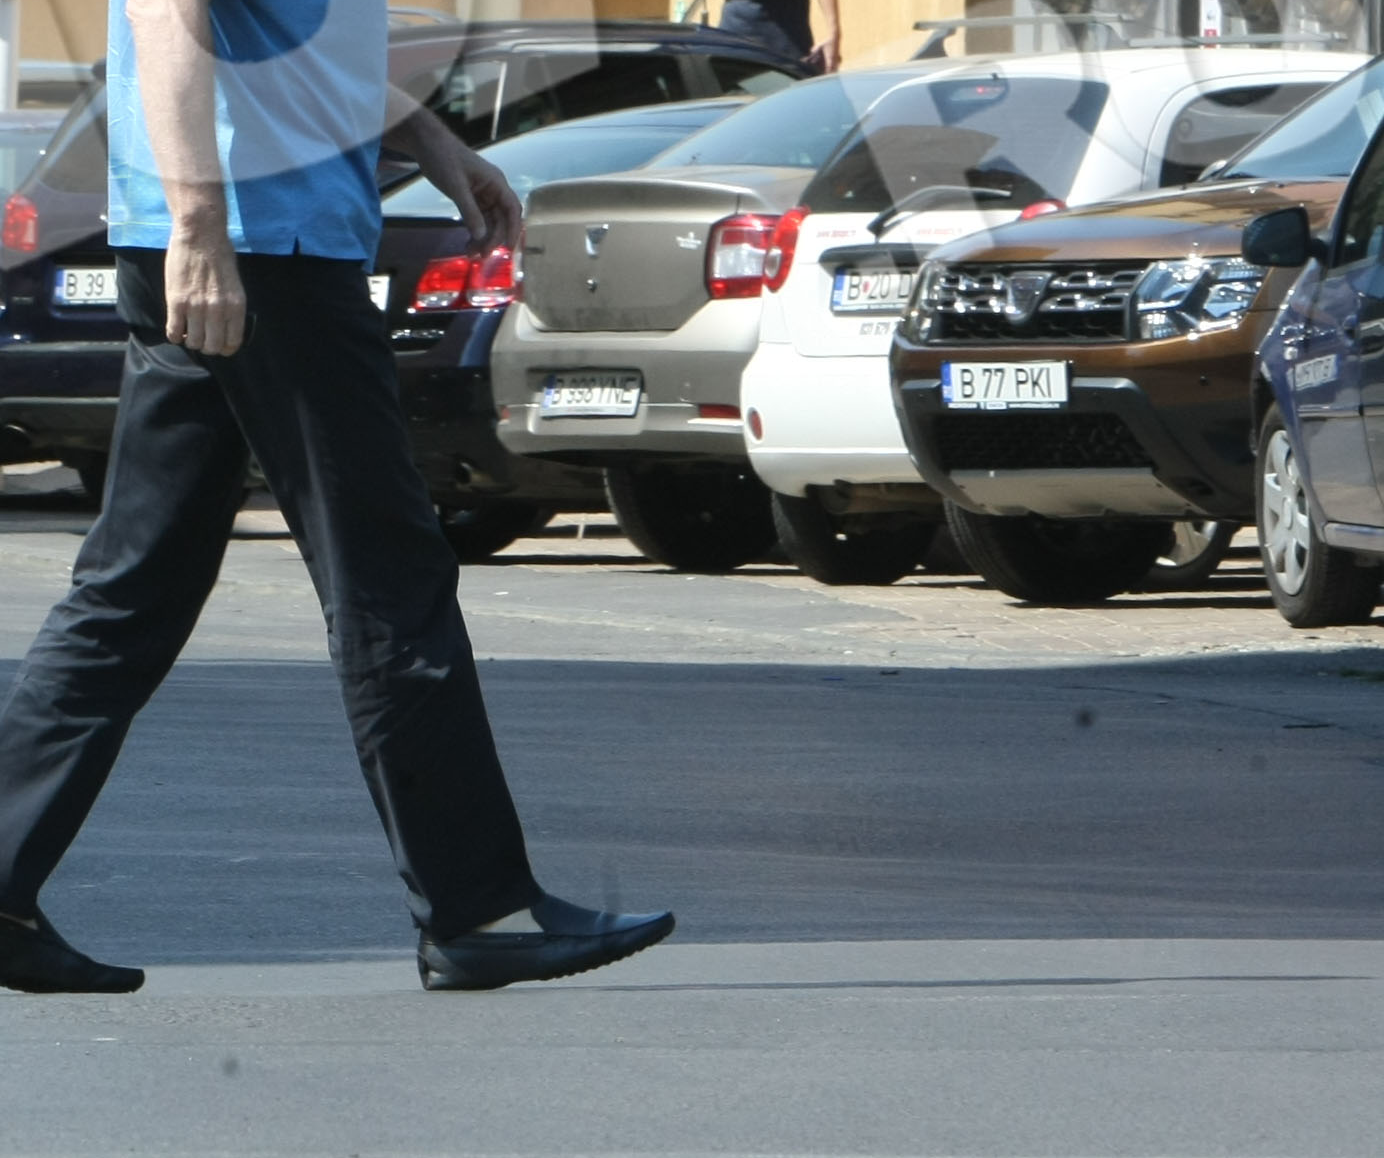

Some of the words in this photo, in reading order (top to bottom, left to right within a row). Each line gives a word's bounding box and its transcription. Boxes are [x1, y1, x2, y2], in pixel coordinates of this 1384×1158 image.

[65, 272, 78, 298] B
[84, 272, 105, 297] 39
[847, 271, 863, 301] B
[867, 271, 892, 300] 20
[551, 377, 564, 405] B
[960, 367, 975, 399] B
[981, 367, 1006, 399] 77
[1013, 367, 1052, 399] PKI
